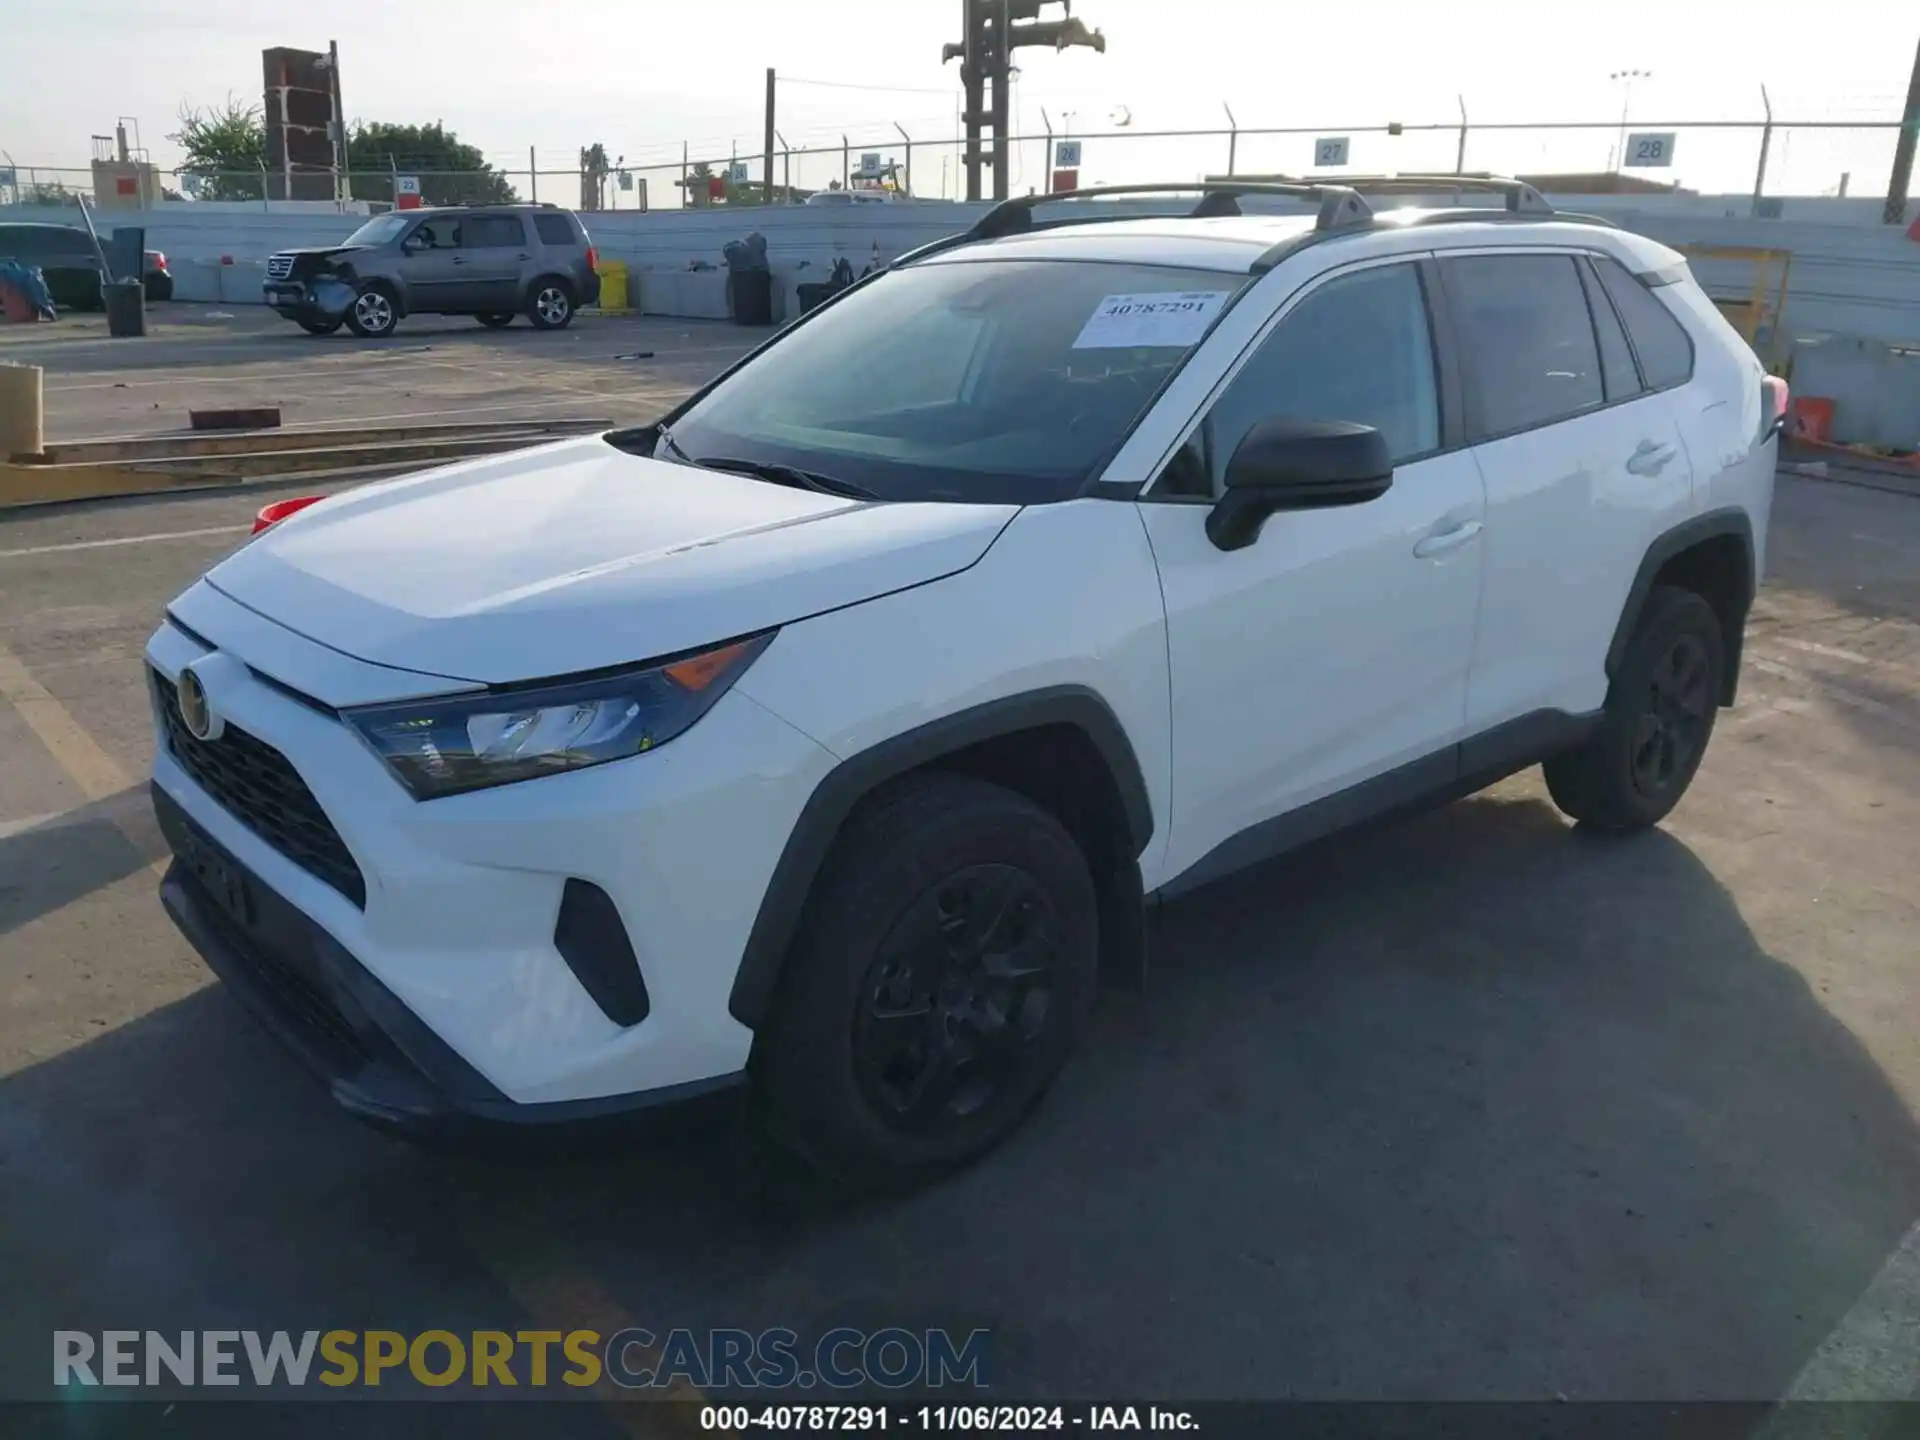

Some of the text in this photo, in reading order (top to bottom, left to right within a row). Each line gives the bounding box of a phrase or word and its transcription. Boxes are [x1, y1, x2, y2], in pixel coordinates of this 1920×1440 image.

[1322, 143, 1342, 160] 27
[1636, 140, 1664, 159] 28
[1105, 302, 1206, 316] 40787291
